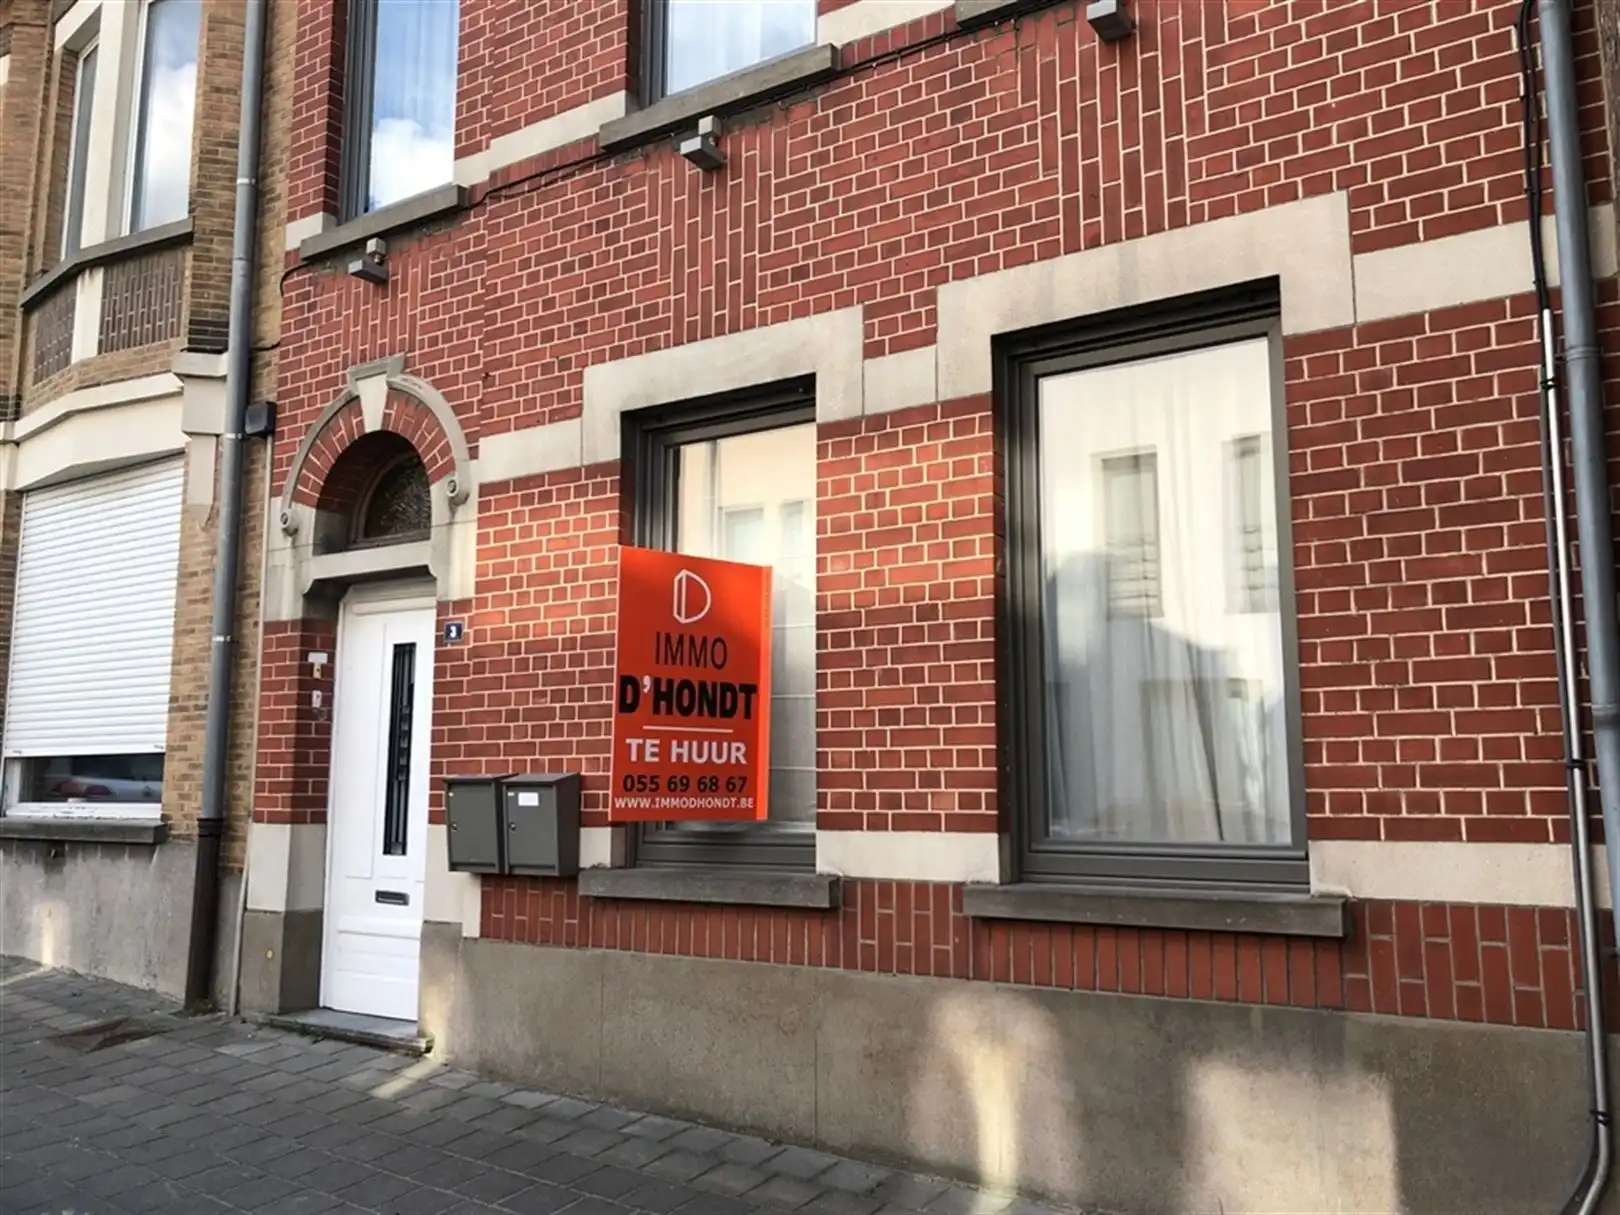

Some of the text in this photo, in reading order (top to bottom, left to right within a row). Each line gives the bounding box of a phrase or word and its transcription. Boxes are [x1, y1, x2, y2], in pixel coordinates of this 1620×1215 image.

[655, 631, 728, 670] IMMO
[619, 674, 758, 719] D'HONDT
[625, 738, 748, 765] TE HUUR
[623, 774, 748, 793] 055 69 68 67
[614, 796, 755, 810] WWW.IMMODHONDT.BE
